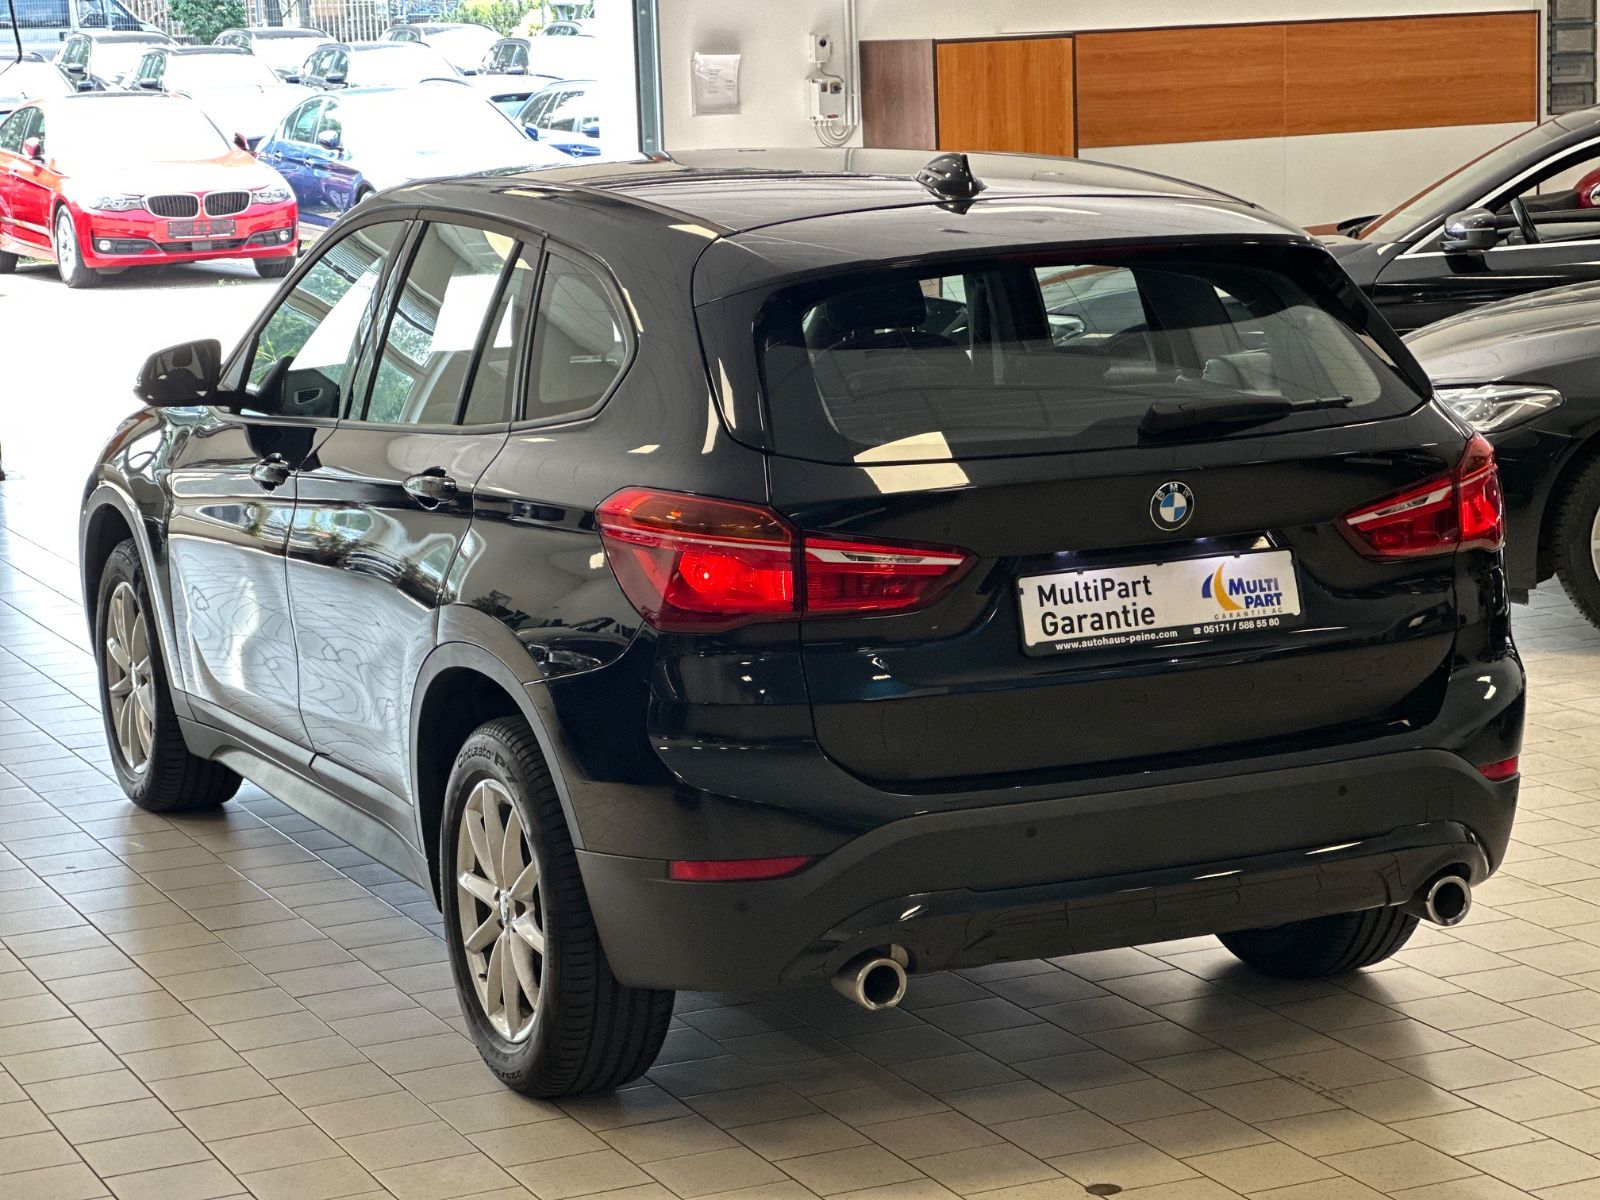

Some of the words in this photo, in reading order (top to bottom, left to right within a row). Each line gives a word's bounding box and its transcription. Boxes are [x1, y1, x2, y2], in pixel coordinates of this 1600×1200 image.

[1155, 483, 1191, 501] BMW
[1037, 575, 1153, 607] MultiPart
[1229, 577, 1279, 596] MULTI
[1244, 592, 1283, 609] PART
[1041, 602, 1155, 637] Garantie
[1214, 608, 1267, 620] GARANTIE
[1203, 623, 1230, 634] 05171
[1238, 619, 1255, 630] 588
[1257, 618, 1267, 628] 55
[1269, 617, 1280, 627] 80
[1055, 630, 1178, 651] www.autohaus-peine.com
[495, 752, 517, 783] P7
